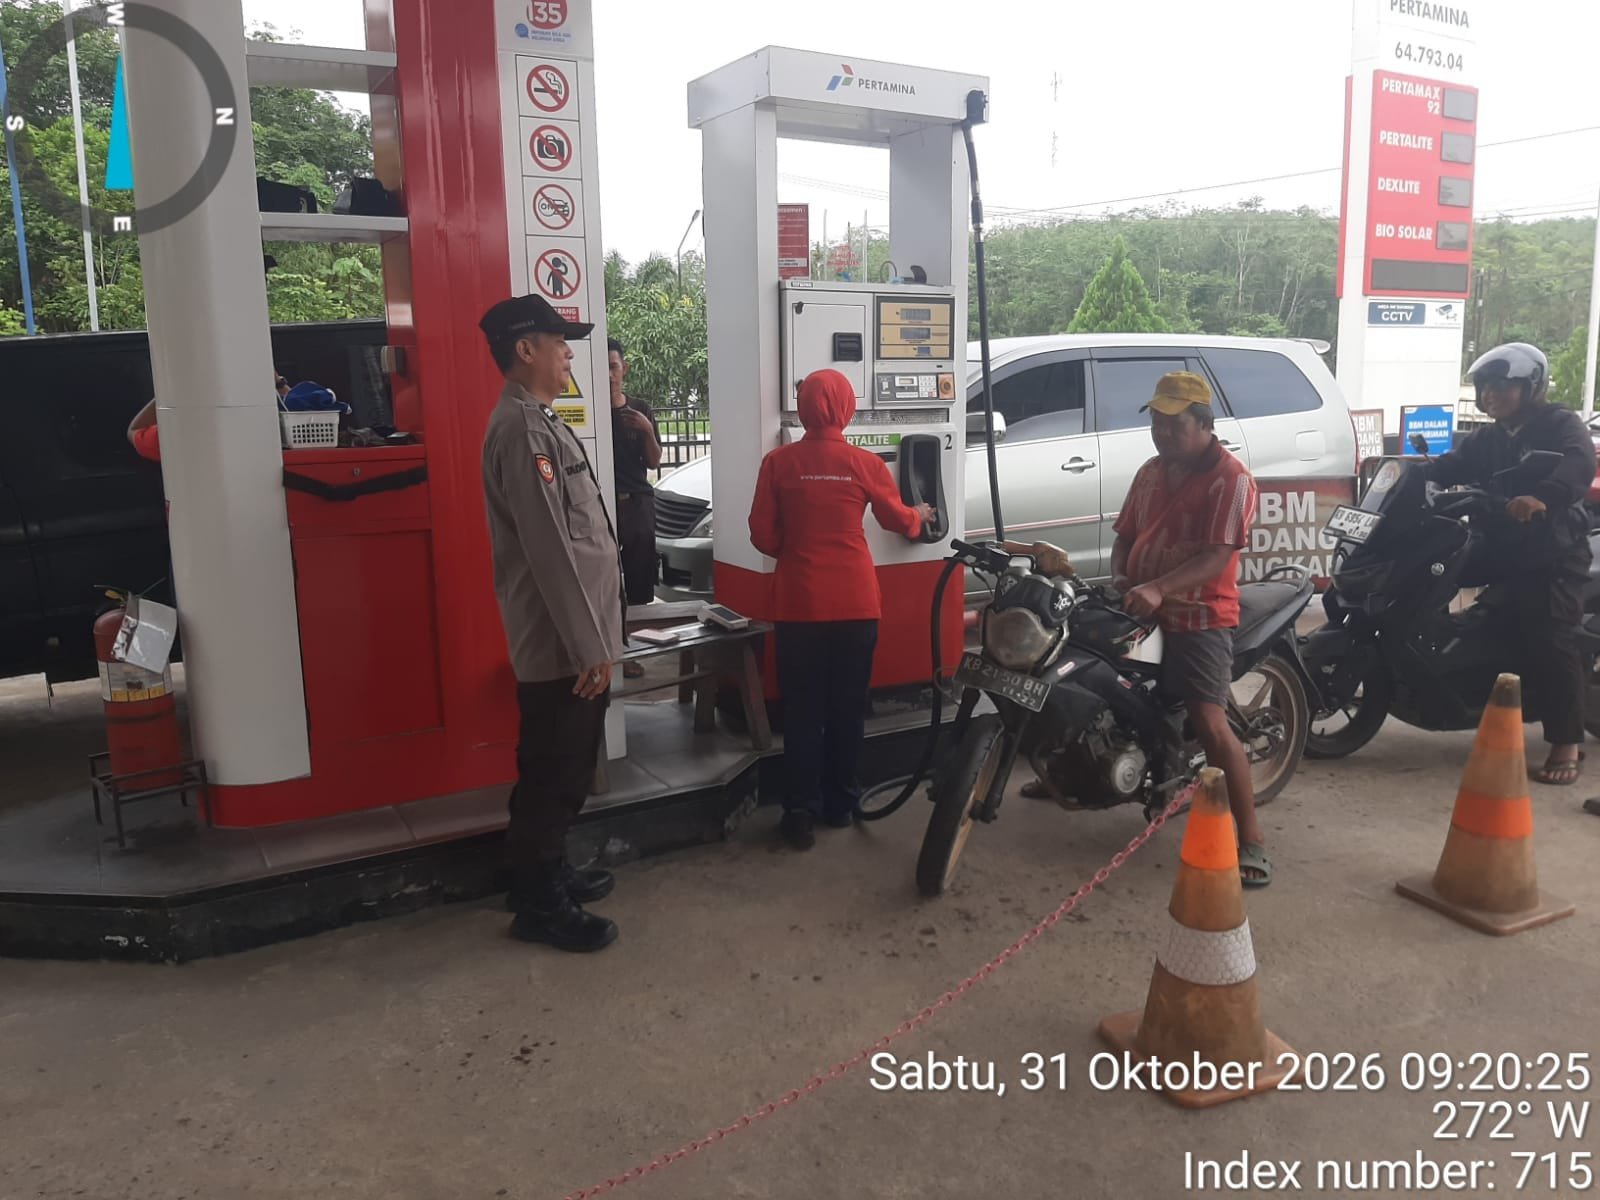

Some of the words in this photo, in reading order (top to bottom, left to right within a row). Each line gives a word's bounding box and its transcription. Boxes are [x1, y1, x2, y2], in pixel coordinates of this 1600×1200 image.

[527, 0, 563, 24] 135
[1390, 0, 1469, 28] PERTAMINA
[1395, 41, 1463, 71] 64.793.04
[858, 78, 916, 95] PERTAMINA
[1382, 77, 1441, 99] PERTAMAX
[1427, 100, 1440, 114] 92
[1380, 130, 1433, 150] PERTALITE
[1377, 177, 1420, 194] DEXLITE
[1375, 224, 1395, 237] BIO
[1398, 225, 1433, 240] SOLAR
[1381, 311, 1413, 321] CCTV
[846, 434, 889, 446] RTALITE
[944, 434, 953, 450] 2
[1250, 491, 1316, 524] BM
[1240, 526, 1338, 553] DANG
